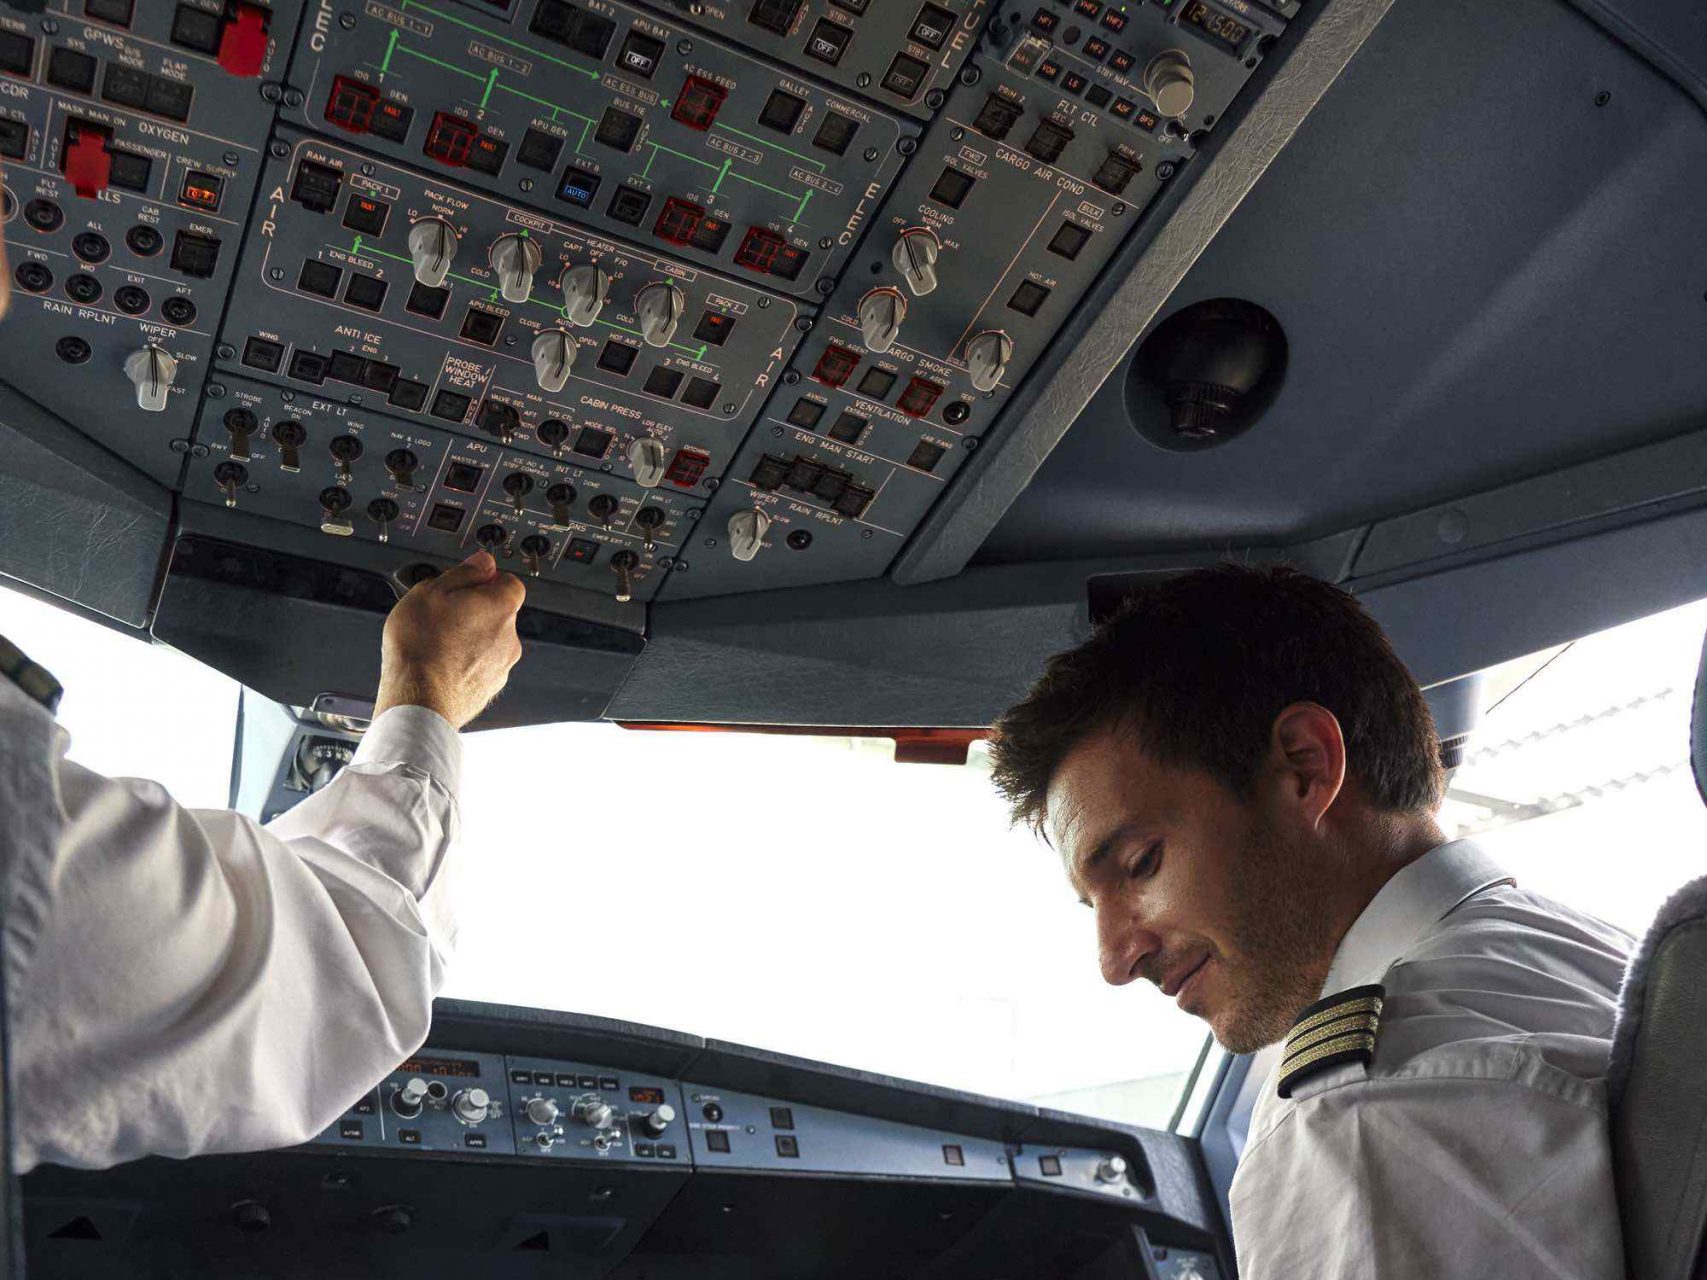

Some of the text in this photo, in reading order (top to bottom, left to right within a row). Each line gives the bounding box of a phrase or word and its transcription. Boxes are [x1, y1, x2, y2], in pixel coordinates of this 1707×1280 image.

[633, 18, 670, 39] APU BAT
[84, 26, 124, 49] GPWS
[163, 58, 188, 71] FLAP
[630, 55, 647, 68] OFF
[161, 67, 187, 80] MODE
[780, 79, 810, 97] GALLEY
[638, 90, 656, 102] BUS
[612, 97, 631, 110] BUS
[58, 101, 109, 122] MASK MAN
[825, 99, 873, 124] COMMERCIAL
[1057, 100, 1099, 127] FLT CTL
[797, 106, 814, 134] AUTO
[138, 123, 189, 145] OXYGEN
[531, 119, 568, 137] APU GEN
[635, 123, 650, 151] AUTO
[115, 138, 167, 159] PASSENGER
[710, 138, 739, 154] AC BUS
[176, 156, 202, 169] CREW
[306, 151, 326, 162] RAM
[963, 149, 982, 162] FWD
[575, 158, 591, 169] EXT
[961, 161, 989, 180] VALVES
[793, 169, 820, 186] AC BUS
[995, 149, 1085, 197] CARGO AIR COND
[361, 179, 382, 192] PACK
[424, 189, 469, 210] PACK FLOW
[567, 187, 587, 199] AUTO
[142, 205, 160, 217] CAB
[261, 186, 285, 237] AIR
[714, 209, 730, 219] GEN
[838, 182, 882, 246] ELEC
[918, 204, 955, 225] COOLING
[138, 214, 160, 225] REST
[514, 214, 546, 230] COCKPIT
[921, 216, 942, 229] NORM
[1080, 216, 1105, 233] VALVES
[189, 223, 213, 235] EMER
[586, 239, 615, 253] HEATER
[27, 251, 48, 261] FWD
[330, 251, 374, 269] ENG BLEED
[470, 267, 490, 278] COLD
[665, 265, 687, 277] CABIN
[127, 274, 146, 284] EXIT
[176, 286, 193, 296] AFT
[43, 301, 117, 326] RAIN RPLNT
[468, 301, 510, 317] APU BLEED
[519, 318, 542, 328] CLOSE
[616, 313, 635, 324] COLD
[139, 322, 177, 338] WIPER
[258, 331, 279, 341] WING
[335, 325, 383, 345] ANTI ICE
[579, 337, 598, 346] OPEN
[176, 351, 198, 361] SLOW
[886, 347, 953, 377] ARGO SMOKE
[447, 357, 483, 375] PROBE
[691, 361, 713, 374] BLEED
[754, 347, 783, 388] AIR
[878, 361, 899, 371] DISCH
[445, 366, 489, 383] WINDOW
[449, 376, 477, 389] HEAT
[235, 392, 263, 404] STROBE
[283, 404, 312, 416] BEACON
[312, 401, 348, 416] EXT LT
[580, 395, 642, 420] CABIN PRESS
[855, 400, 911, 425] VENTILATION
[467, 442, 487, 453] APU
[795, 432, 874, 465] ENG MAN START
[451, 454, 479, 465] MASTER
[750, 490, 778, 505] WIPER
[789, 503, 812, 516] RAIN
